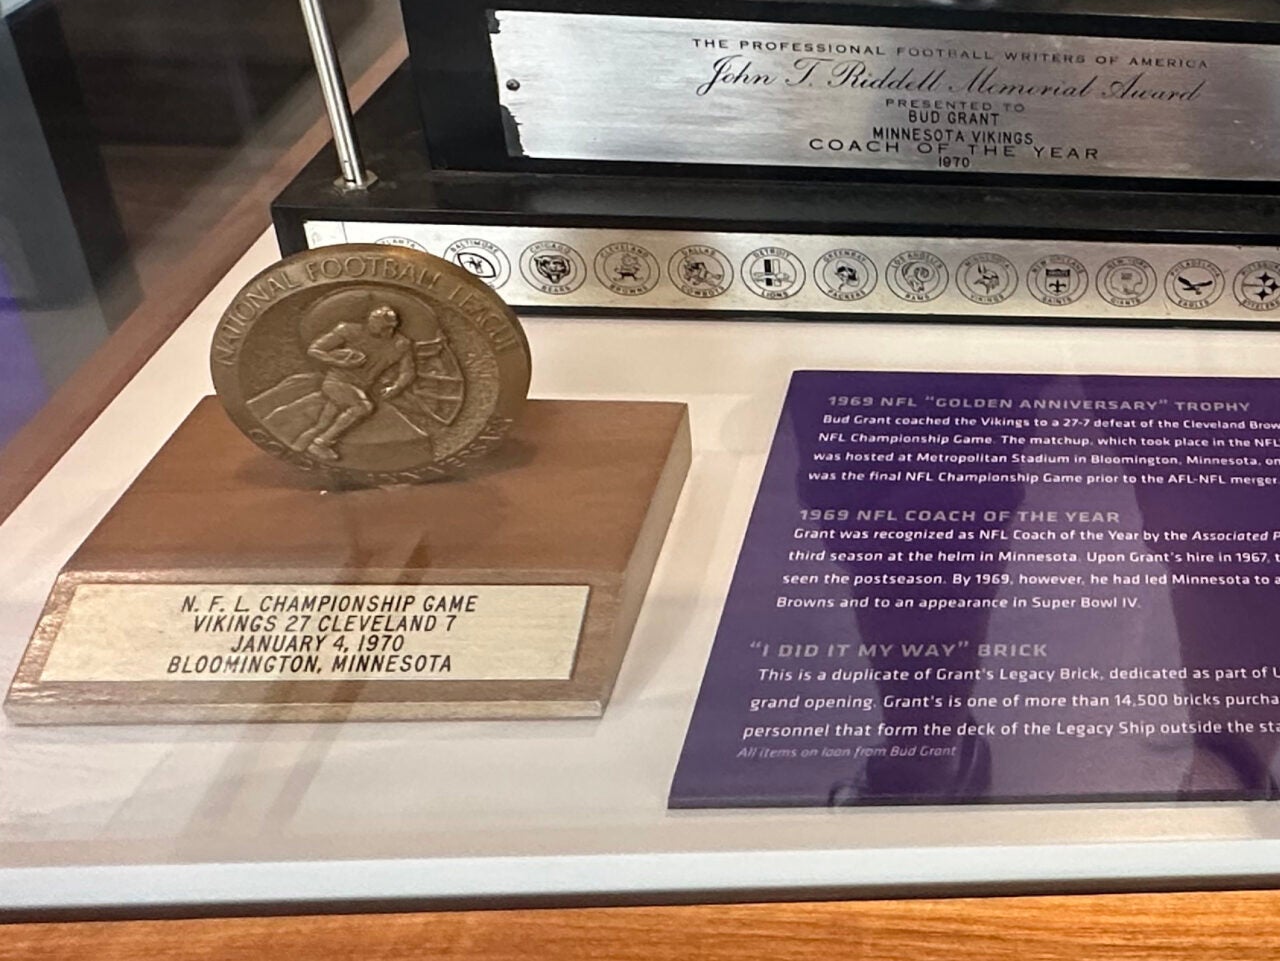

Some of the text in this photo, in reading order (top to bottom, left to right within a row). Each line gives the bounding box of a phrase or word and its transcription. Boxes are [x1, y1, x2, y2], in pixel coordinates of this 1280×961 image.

[691, 38, 1207, 68] THE PROFESSIONAL FOOTBALL WRITERS OF AMERICA
[696, 54, 777, 96] John
[827, 59, 947, 92] Riddell
[948, 66, 1098, 99] Memorial
[1101, 71, 1207, 102] Award
[885, 98, 1025, 113] PRESENTED TO
[908, 109, 1000, 126] BUD GRANT
[872, 126, 1033, 146] MINNESOTA VIKINGS
[808, 137, 1098, 160] COACH OF THE YEAR
[938, 156, 970, 169] 1970
[216, 271, 303, 367] NATIONAL
[304, 255, 443, 290] FOOTBALL
[828, 396, 874, 407] 1969
[880, 397, 917, 407] NFL
[1174, 401, 1250, 412] TROPHY
[800, 509, 1119, 523] 1969 NFL COACH OF THE YEAR
[180, 594, 479, 613] N. F. L. CHAMPIONSHIP GAME
[776, 596, 1141, 611] Browns and to an appearance in Super Bowl IV.
[193, 614, 458, 633] VIKINGS 27 CLEVELAND 7
[230, 634, 405, 654] JANUARY 4, 1970
[777, 644, 819, 658] DID
[827, 644, 851, 657] IT
[858, 644, 894, 657] MY
[977, 643, 1047, 657] BRICK
[166, 654, 451, 675] BLOOMINGTON, MINNESOTA
[759, 668, 793, 681] This
[798, 671, 812, 681] is
[816, 671, 827, 681] a
[831, 668, 910, 684] duplicate
[913, 667, 933, 681] of
[936, 668, 994, 681] Grant's
[999, 668, 1055, 683] Legacy
[1060, 667, 1104, 680] Brick,
[1109, 667, 1187, 680] dedicated
[1192, 669, 1210, 679] as
[1215, 668, 1248, 682] part
[1251, 666, 1268, 679] of
[750, 695, 801, 712] grand
[804, 695, 877, 712] opening.
[883, 695, 943, 708] Grant's
[948, 695, 962, 708] is
[966, 697, 998, 708] one
[1002, 694, 1020, 708] of
[1024, 696, 1067, 707] more
[1071, 694, 1109, 707] than
[1114, 694, 1168, 707] 14,500
[1173, 693, 1221, 706] bricks
[742, 723, 830, 740] personnel
[835, 723, 872, 737] that
[877, 722, 918, 737] form
[923, 722, 952, 736] the
[956, 722, 996, 736] deck
[1000, 721, 1018, 736] of
[1024, 722, 1051, 736] the
[1056, 722, 1114, 738] Legacy
[1118, 721, 1155, 737] Ship
[1160, 720, 1222, 734] outside
[1227, 720, 1254, 733] the
